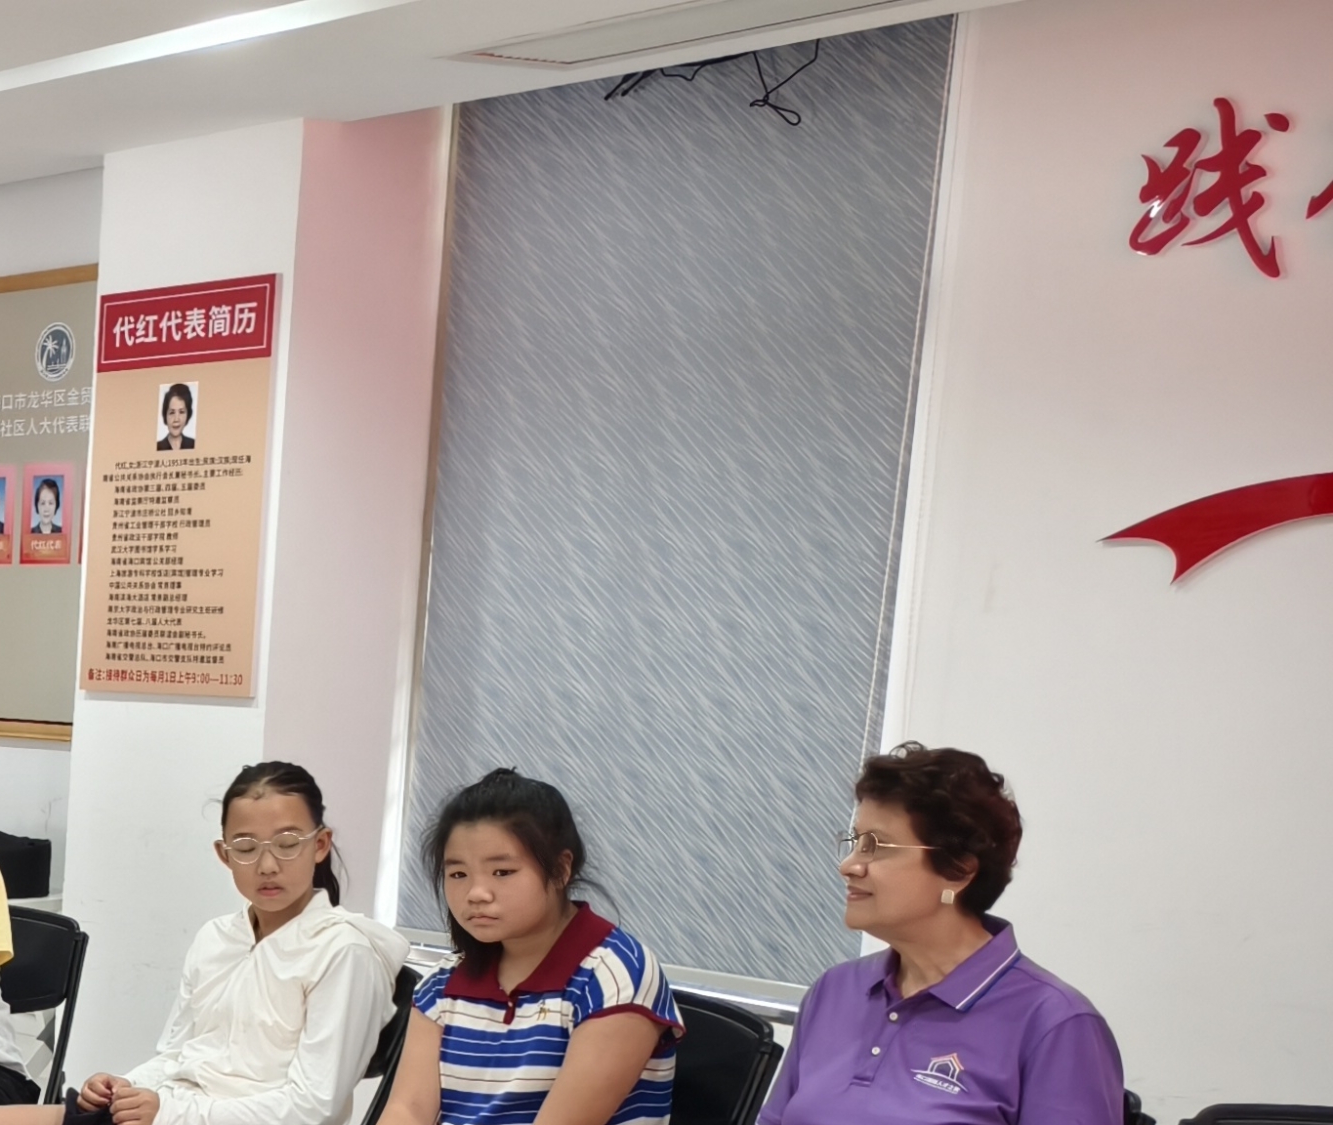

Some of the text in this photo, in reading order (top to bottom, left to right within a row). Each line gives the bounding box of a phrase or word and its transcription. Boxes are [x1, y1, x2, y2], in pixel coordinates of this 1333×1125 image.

[1129, 97, 1333, 278] 践
[113, 302, 258, 348] 代红代表简历
